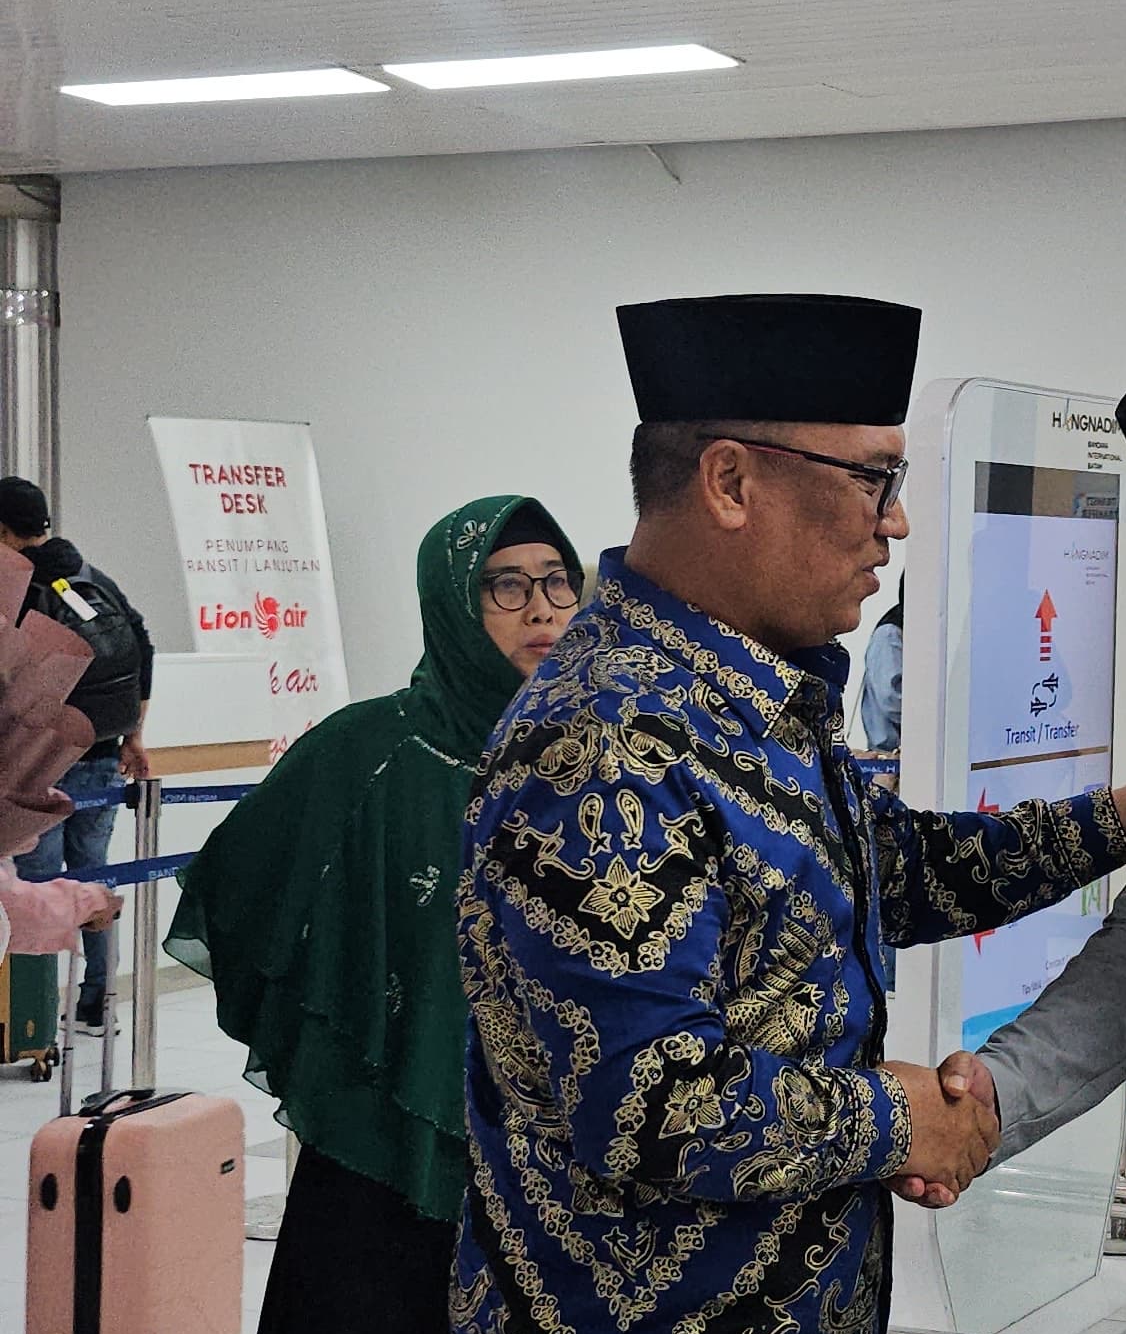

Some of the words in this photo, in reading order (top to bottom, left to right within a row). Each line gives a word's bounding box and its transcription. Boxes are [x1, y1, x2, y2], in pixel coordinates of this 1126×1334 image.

[189, 463, 287, 488] TRANSFER
[220, 492, 268, 515] DESK
[205, 538, 289, 554] PENUMPANG
[185, 558, 239, 573] RANSIT
[255, 558, 320, 573] LANJUTAN
[199, 603, 252, 632] Lion
[283, 602, 308, 629] air
[1005, 726, 1036, 745] Transit
[1037, 722, 1043, 744] /
[1045, 720, 1080, 740] Transfer
